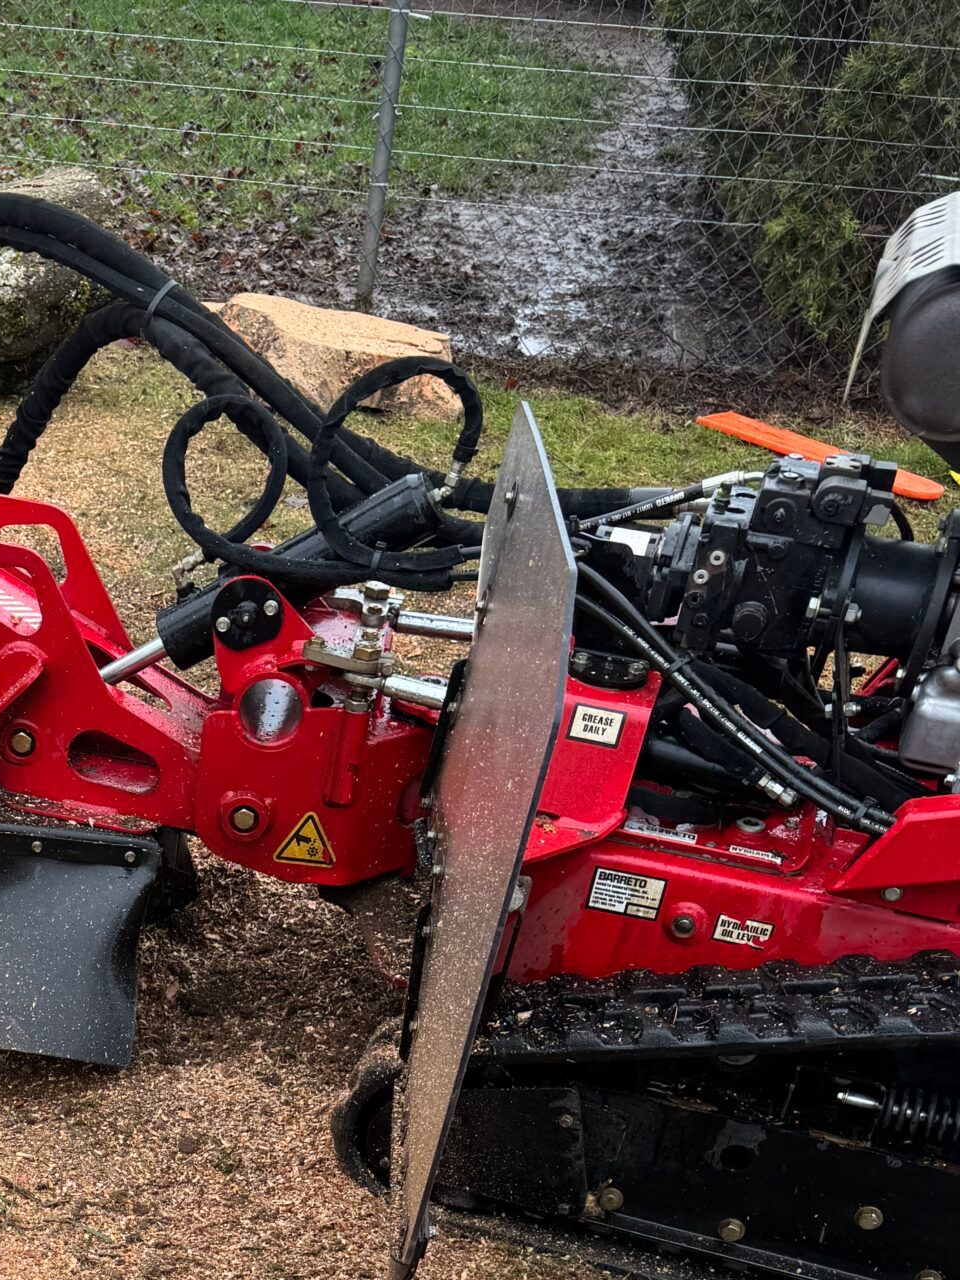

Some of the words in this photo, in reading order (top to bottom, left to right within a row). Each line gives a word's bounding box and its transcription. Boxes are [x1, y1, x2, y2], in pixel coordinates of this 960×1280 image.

[582, 713, 615, 727] GREASE
[582, 724, 607, 736] DAILY
[598, 871, 648, 889] BARRETO
[721, 928, 734, 939] OIL
